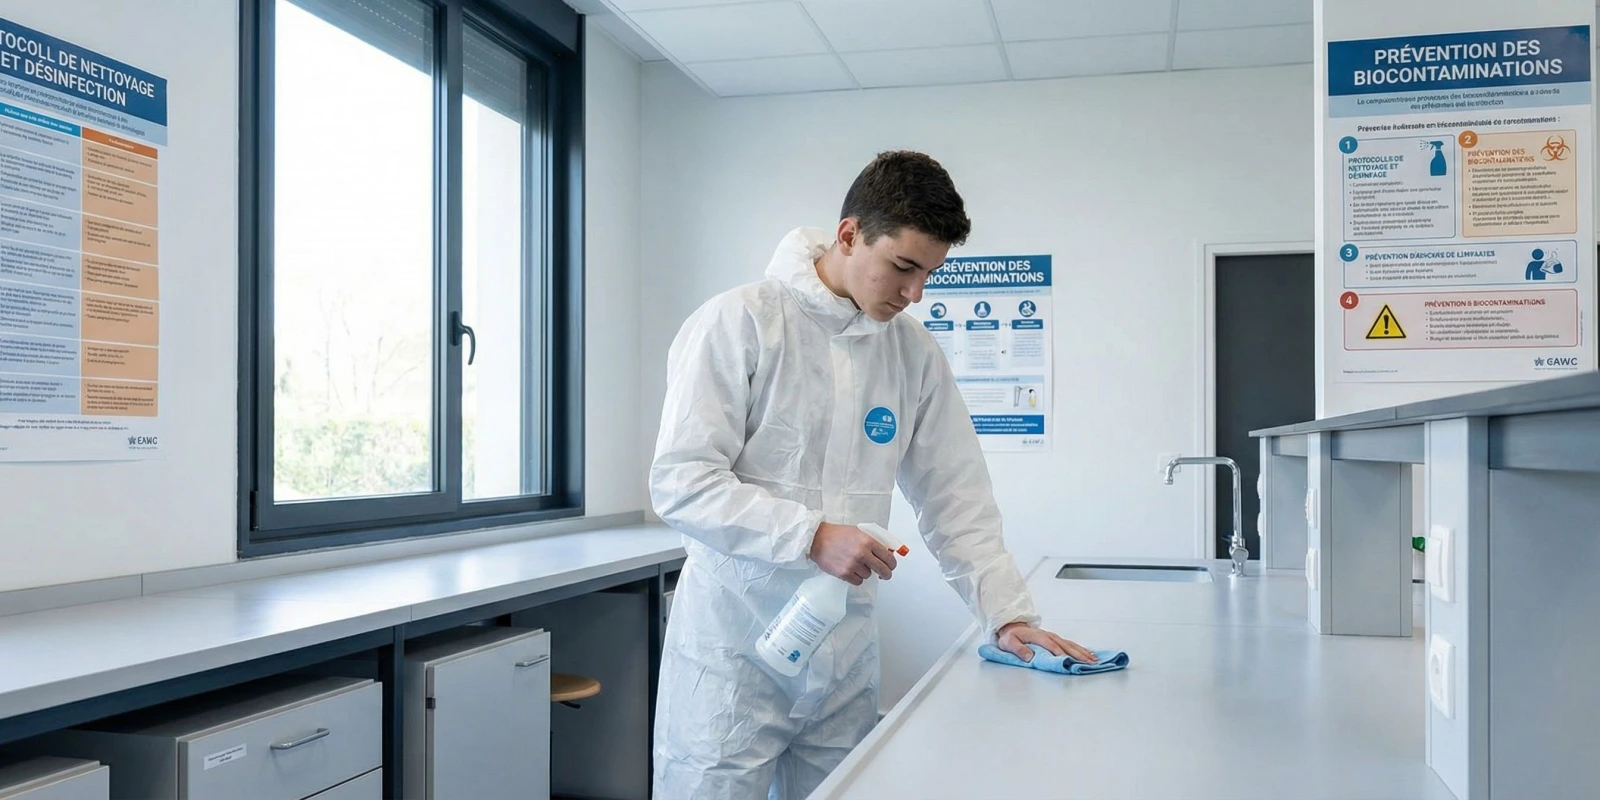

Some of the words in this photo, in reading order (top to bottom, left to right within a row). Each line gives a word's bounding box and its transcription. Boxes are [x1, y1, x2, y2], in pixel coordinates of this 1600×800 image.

[1374, 42, 1497, 65] PRÉVENTION
[1503, 39, 1541, 57] DES
[59, 50, 77, 70] DE
[81, 58, 154, 98] NETTOYAGE
[1354, 58, 1563, 86] BIOCONTAMINATIONS
[1, 50, 21, 71] ET
[25, 58, 126, 106] DÉSINFECTION
[1464, 135, 1472, 144] 2
[1345, 140, 1351, 150] 1
[1345, 248, 1353, 257] 3
[1365, 252, 1409, 261] PRÉVENTION
[1008, 260, 1031, 271] DES
[1345, 295, 1353, 305] 4
[1425, 299, 1467, 308] PRÉVENTION
